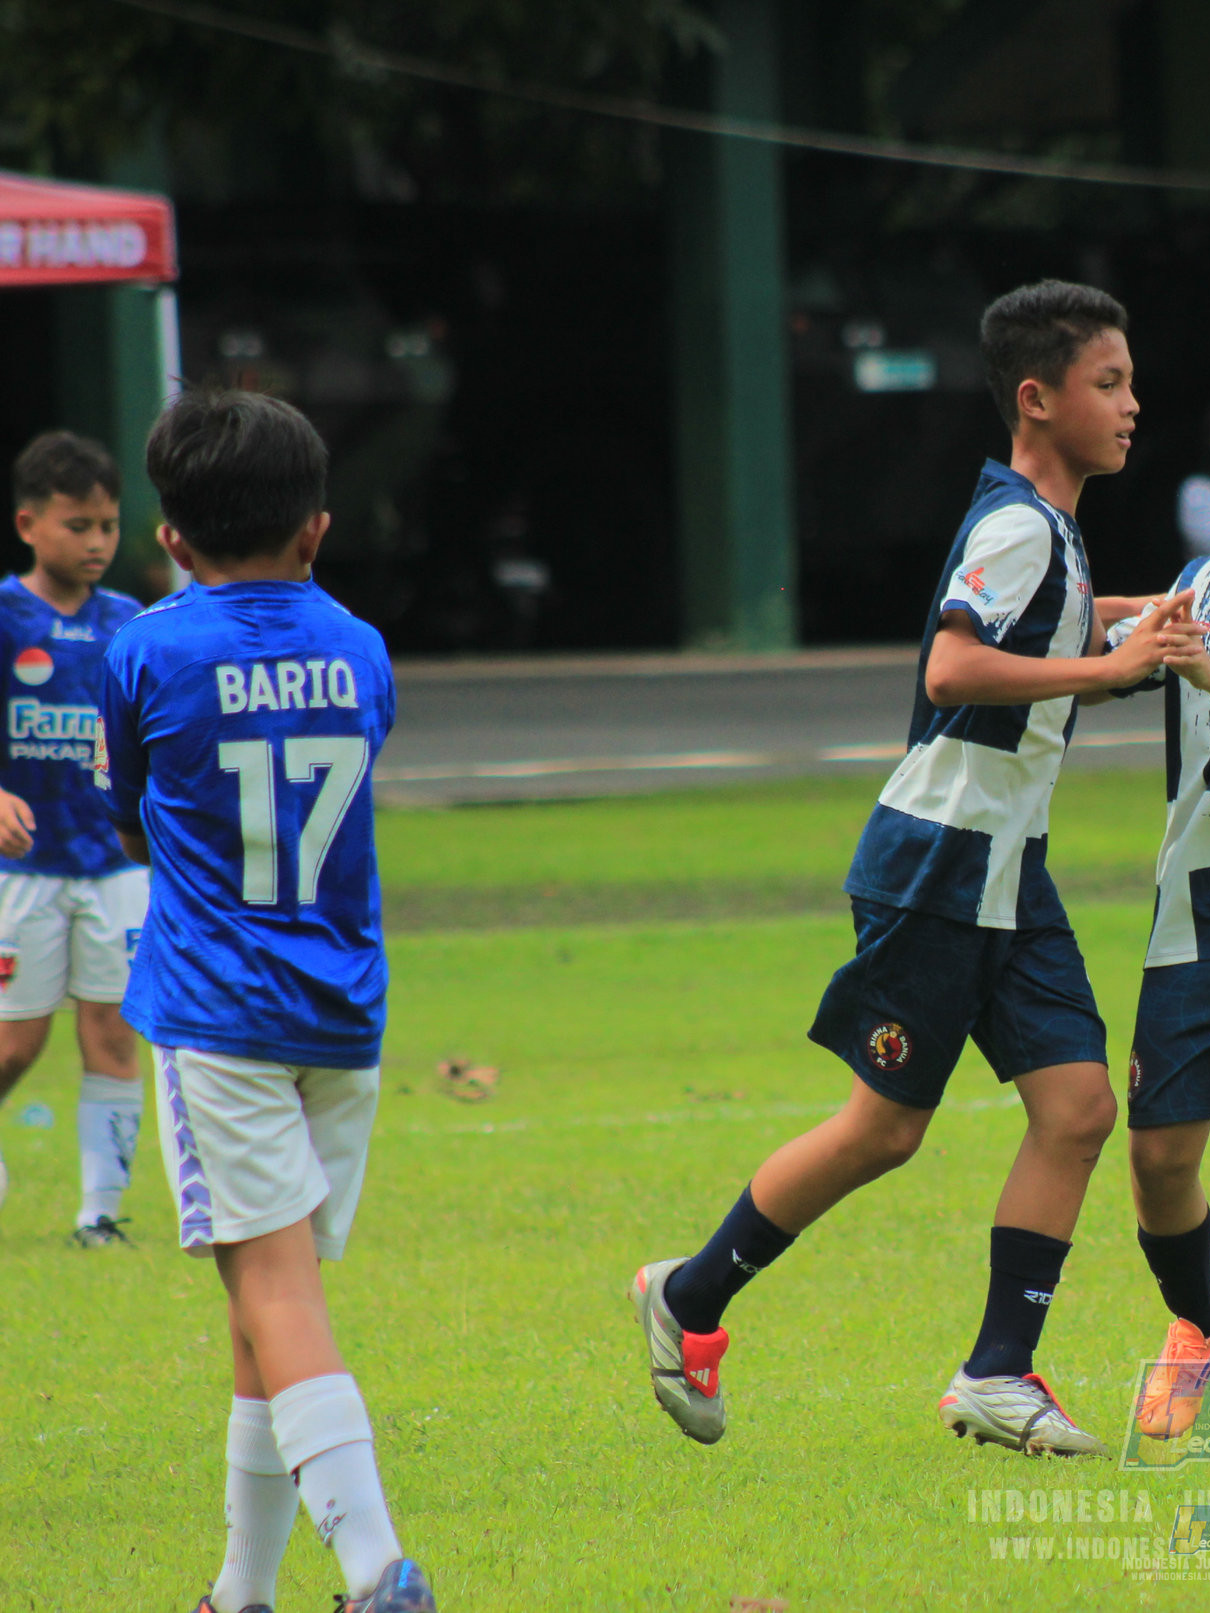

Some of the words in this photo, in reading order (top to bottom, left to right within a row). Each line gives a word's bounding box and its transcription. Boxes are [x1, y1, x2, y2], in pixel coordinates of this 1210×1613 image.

[27, 218, 147, 269] HAND
[216, 658, 358, 714] BARIQ
[218, 736, 369, 905] 17
